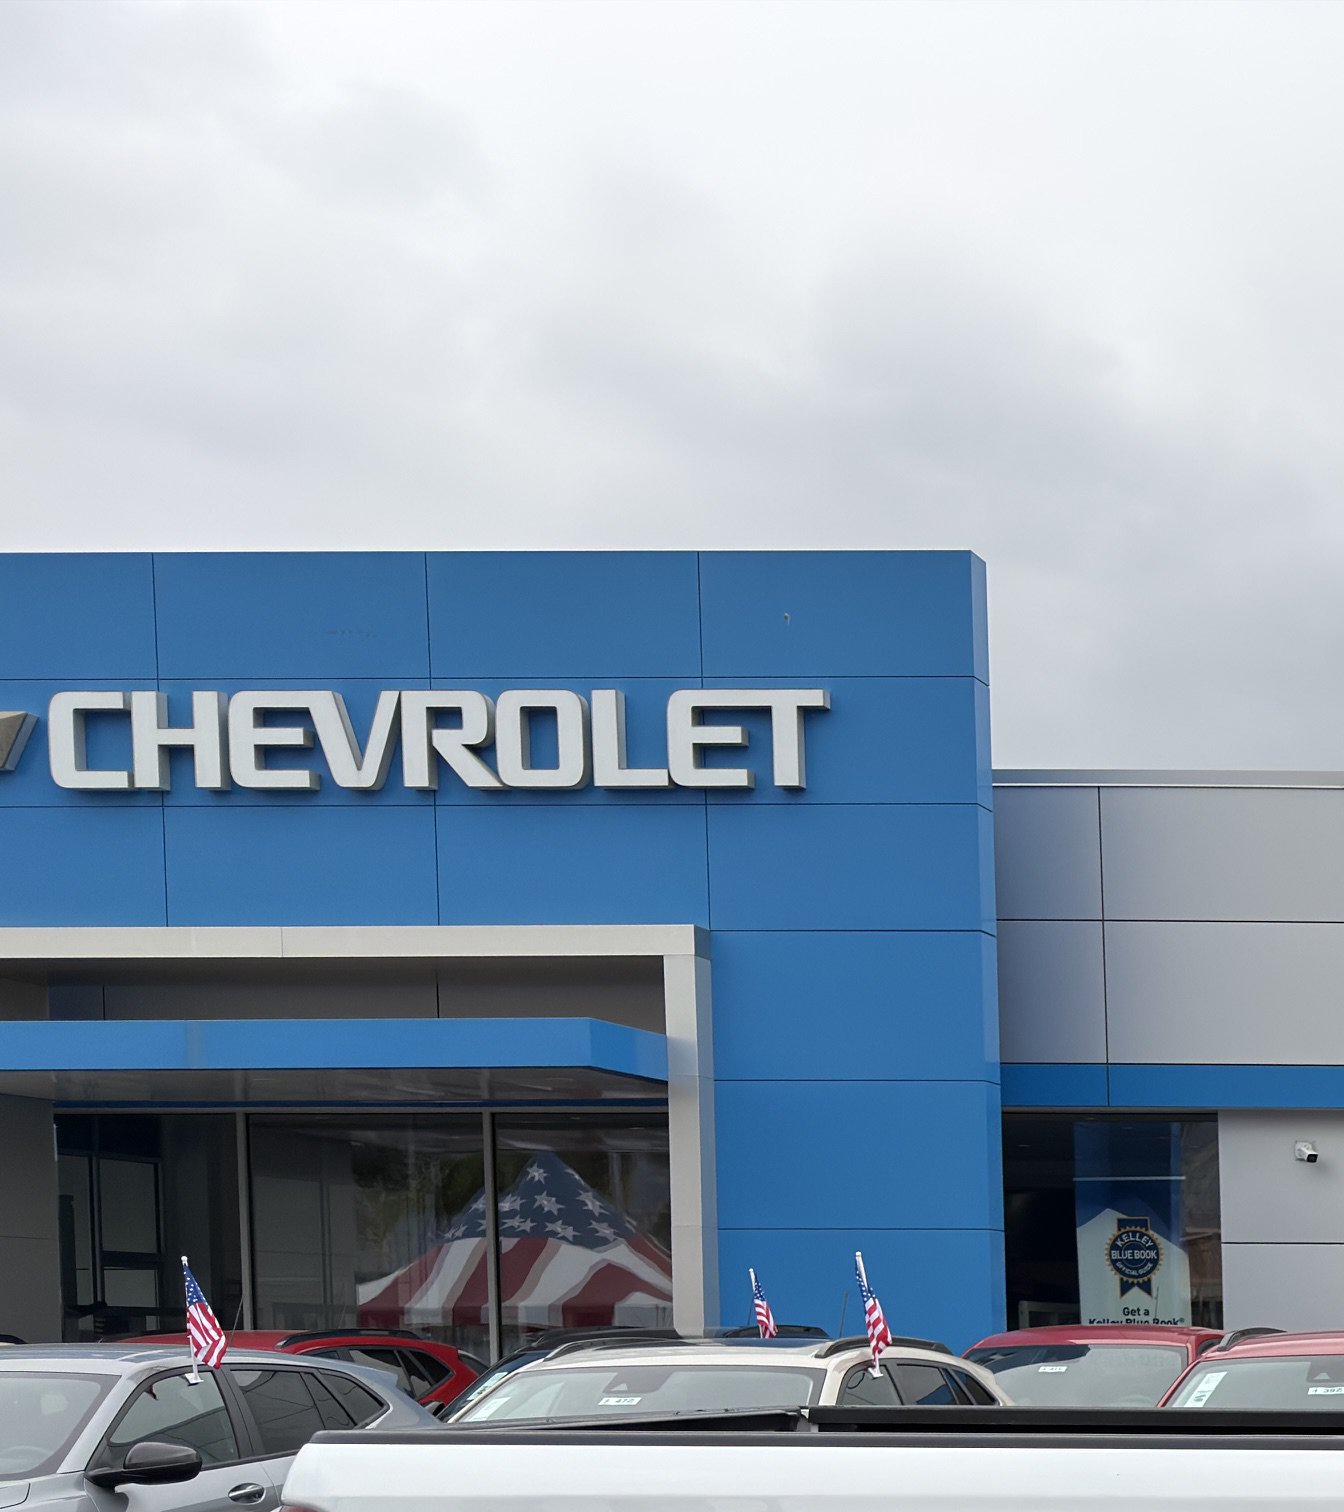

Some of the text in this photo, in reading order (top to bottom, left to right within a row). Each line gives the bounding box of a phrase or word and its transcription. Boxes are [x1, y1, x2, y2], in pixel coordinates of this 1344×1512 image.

[48, 689, 831, 791] CHEVROLET
[1115, 1232, 1154, 1247] KELLEY
[1111, 1250, 1157, 1259] BLUE BOOK
[1122, 1307, 1142, 1316] Get
